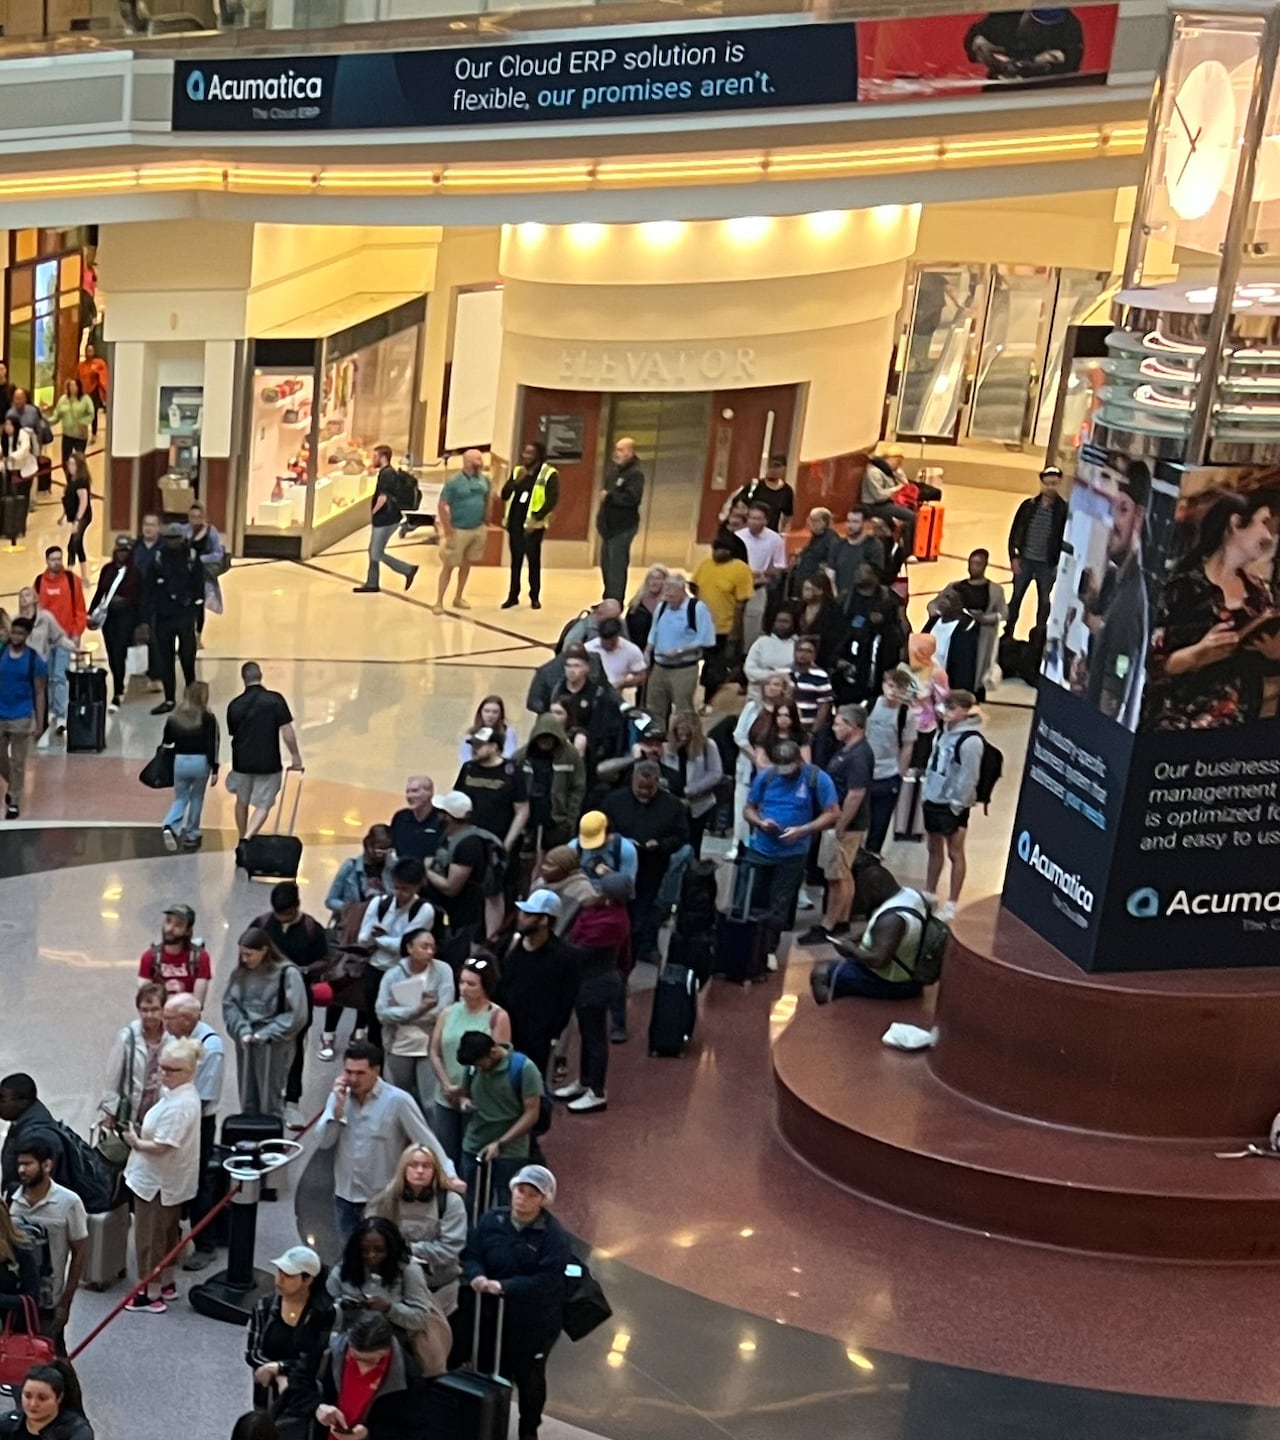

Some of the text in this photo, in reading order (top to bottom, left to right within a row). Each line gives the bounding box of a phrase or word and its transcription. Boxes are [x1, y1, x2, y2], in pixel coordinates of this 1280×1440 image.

[454, 41, 745, 80] Our Cloud ERP solution is
[207, 70, 322, 100] Acumatica
[453, 86, 530, 111] flexible,
[537, 87, 576, 107] our
[581, 78, 692, 109] promises
[559, 347, 756, 382] ELEVATOR
[1154, 758, 1280, 780] Our business
[1148, 781, 1278, 805] management
[1145, 803, 1280, 829] is optimized fo
[1140, 830, 1280, 851] and easy to us
[1028, 843, 1094, 913] Acumatica
[1165, 890, 1280, 917] Acuma
